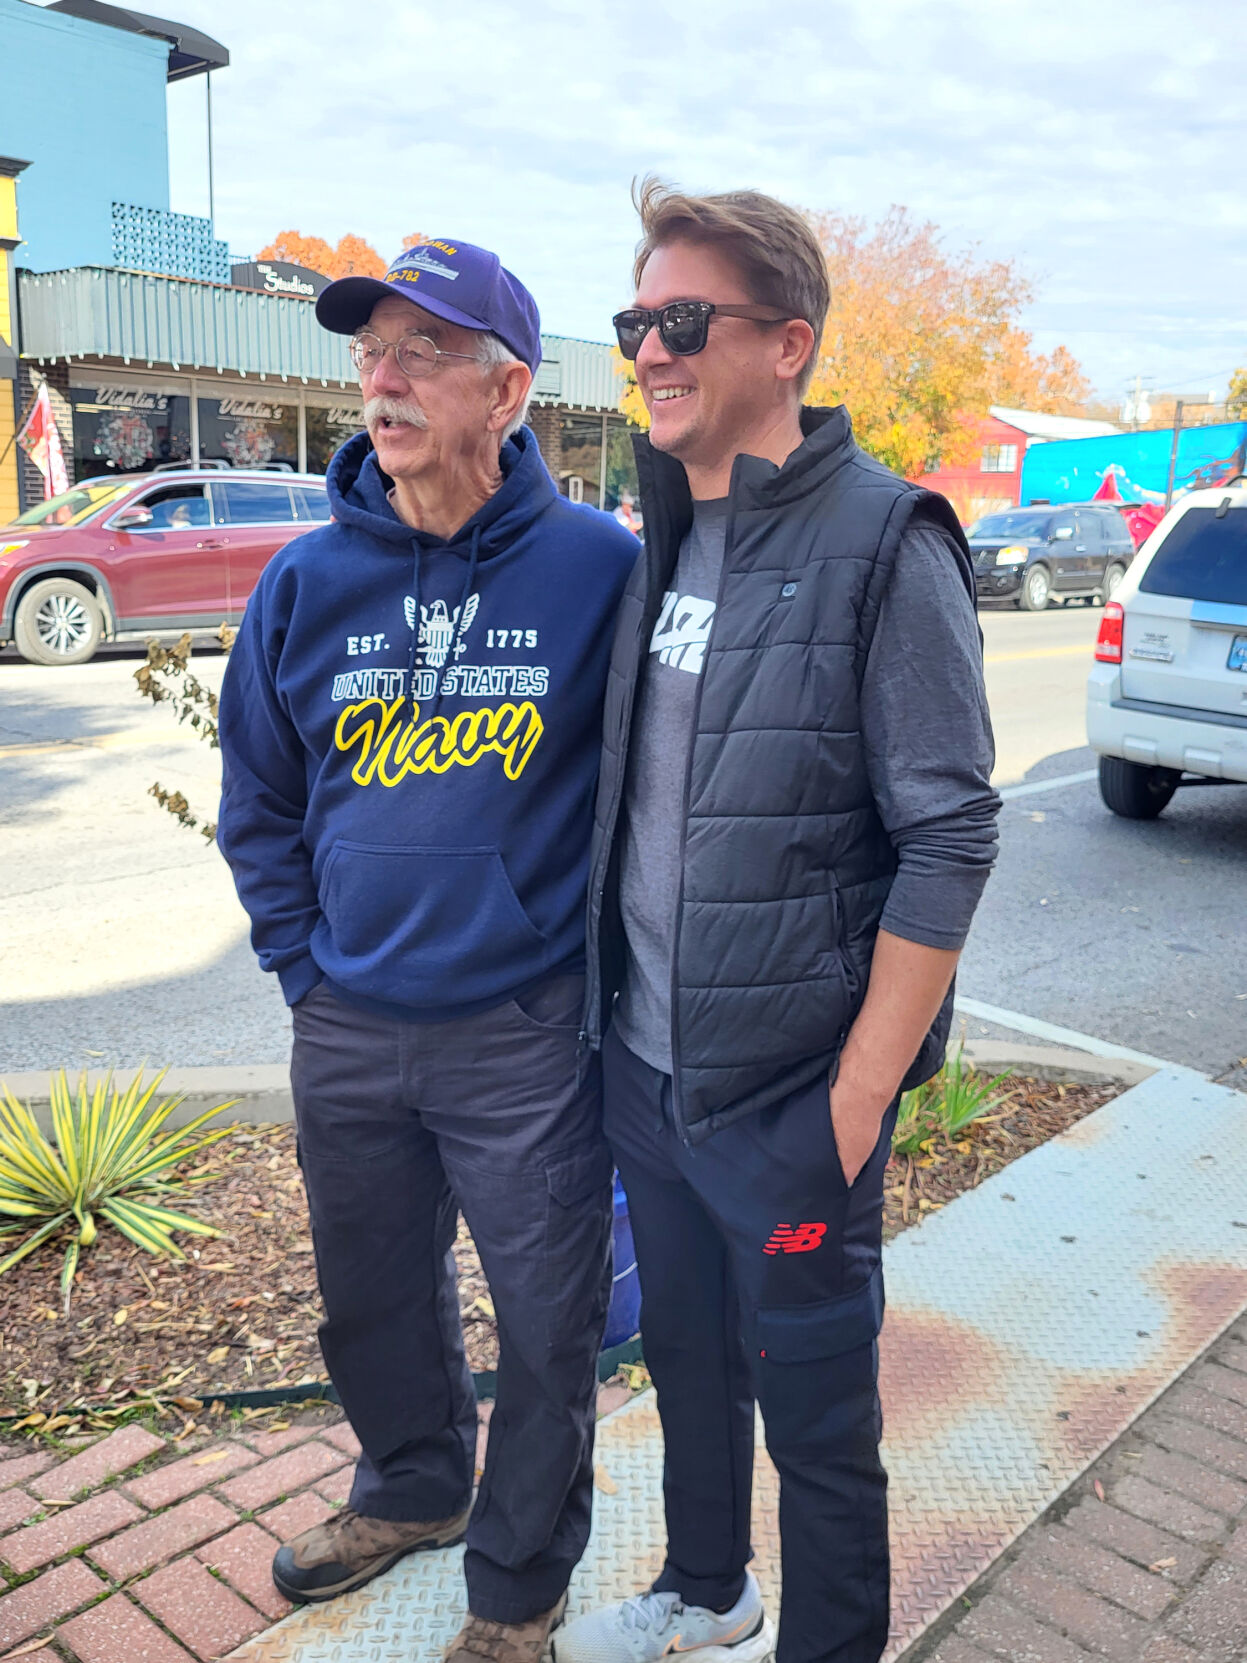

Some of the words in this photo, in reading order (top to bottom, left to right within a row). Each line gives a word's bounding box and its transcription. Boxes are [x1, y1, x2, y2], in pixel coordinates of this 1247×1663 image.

[421, 240, 458, 256] OWAN
[263, 271, 315, 296] Studios
[95, 384, 169, 409] Vidalia's
[218, 398, 283, 419] Vidalia's
[346, 633, 391, 656] EST.
[486, 629, 538, 649] 1775
[331, 668, 438, 701] UNITED
[440, 665, 549, 697] STATES
[334, 695, 545, 788] Navy
